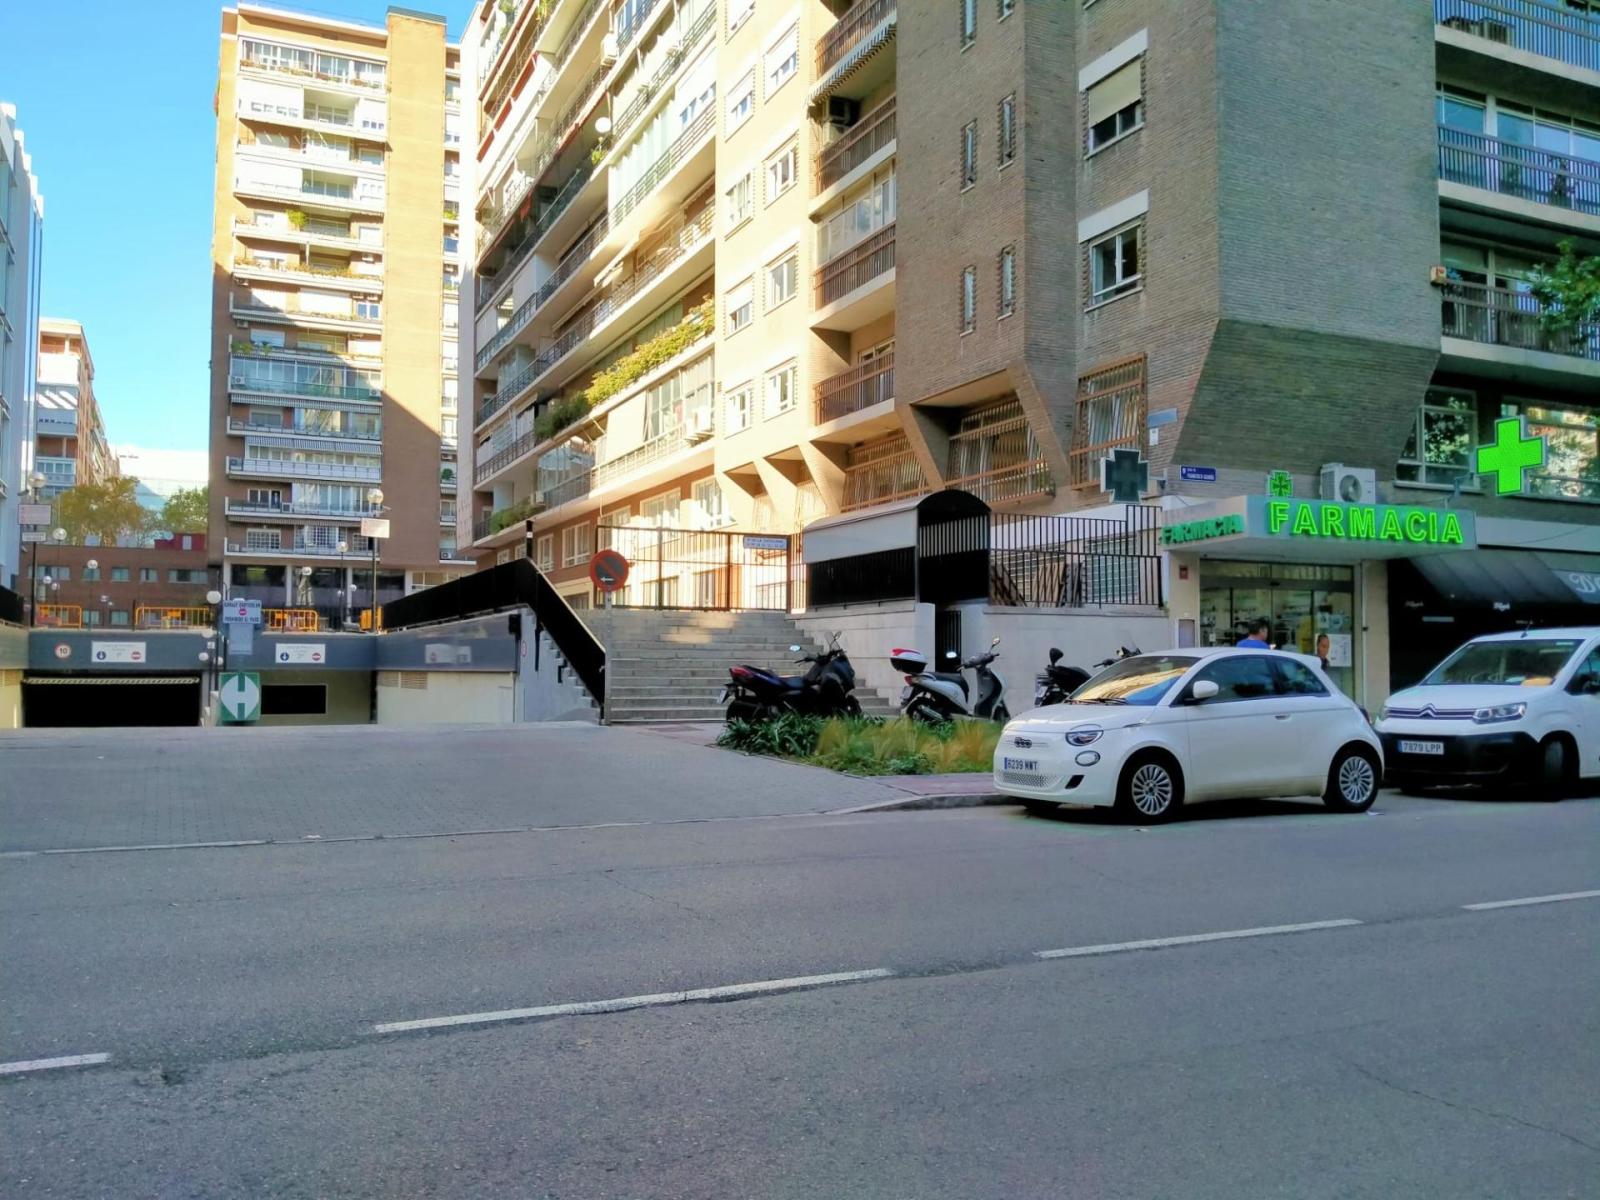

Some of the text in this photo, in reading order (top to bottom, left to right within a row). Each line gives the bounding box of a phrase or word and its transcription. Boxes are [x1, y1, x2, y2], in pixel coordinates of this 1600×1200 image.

[1161, 514, 1245, 546] FARMACIA
[1268, 501, 1464, 545] FARMACIA
[60, 647, 68, 655] 10
[1403, 742, 1441, 753] 7879 LPP
